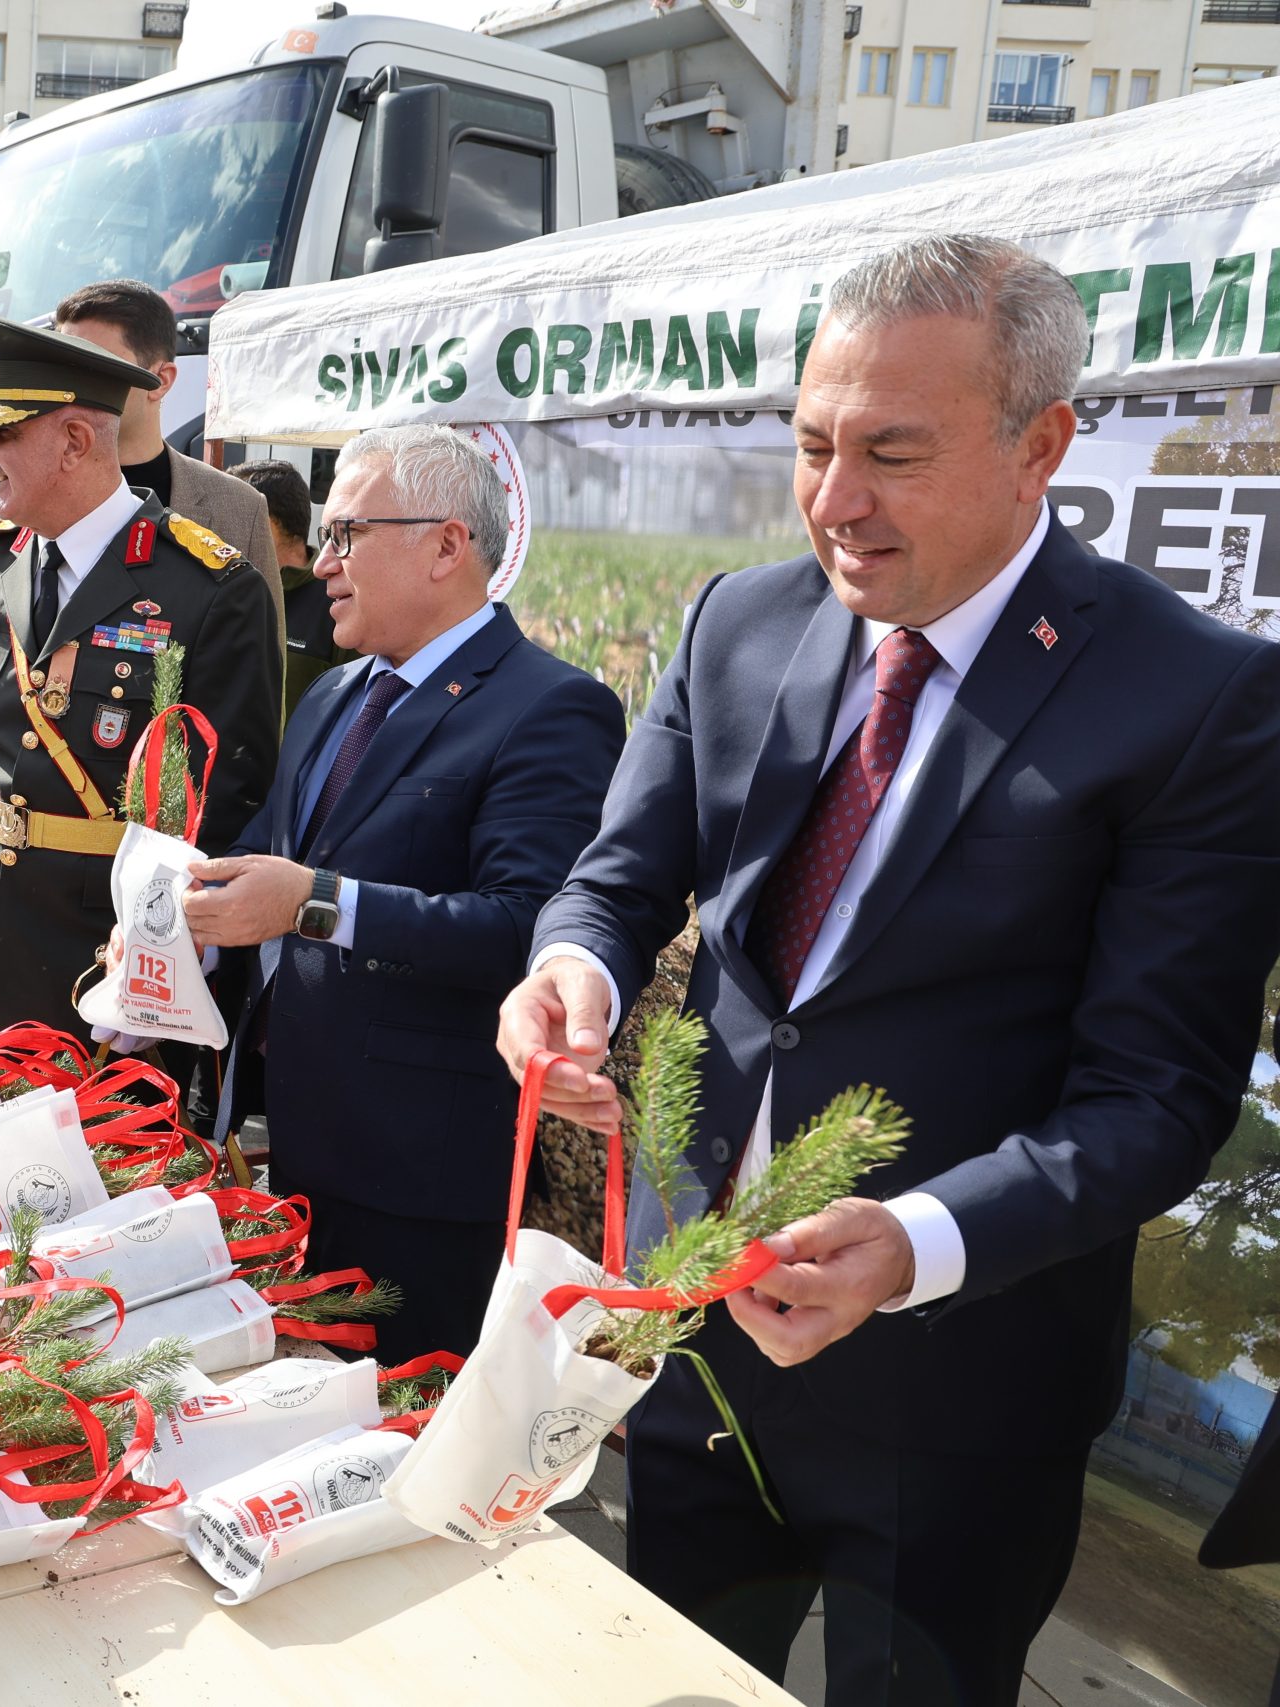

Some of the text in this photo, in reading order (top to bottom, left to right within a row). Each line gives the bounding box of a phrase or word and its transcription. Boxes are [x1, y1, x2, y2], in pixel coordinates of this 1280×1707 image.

[314, 337, 469, 412] SİVAS
[496, 307, 761, 400] ORMAN
[137, 953, 167, 984] 112
[142, 983, 160, 994] ACİL
[140, 1011, 160, 1022] SİVAS
[173, 1008, 192, 1016] HATTI
[551, 1410, 594, 1423] GENEL
[170, 1423, 184, 1445] HATTI
[326, 1479, 338, 1502] OGM
[232, 1507, 255, 1537] YANGINI
[459, 1503, 488, 1530] ORMAN
[210, 1516, 235, 1547] İŞLETME
[445, 1521, 477, 1544] ORMAN
